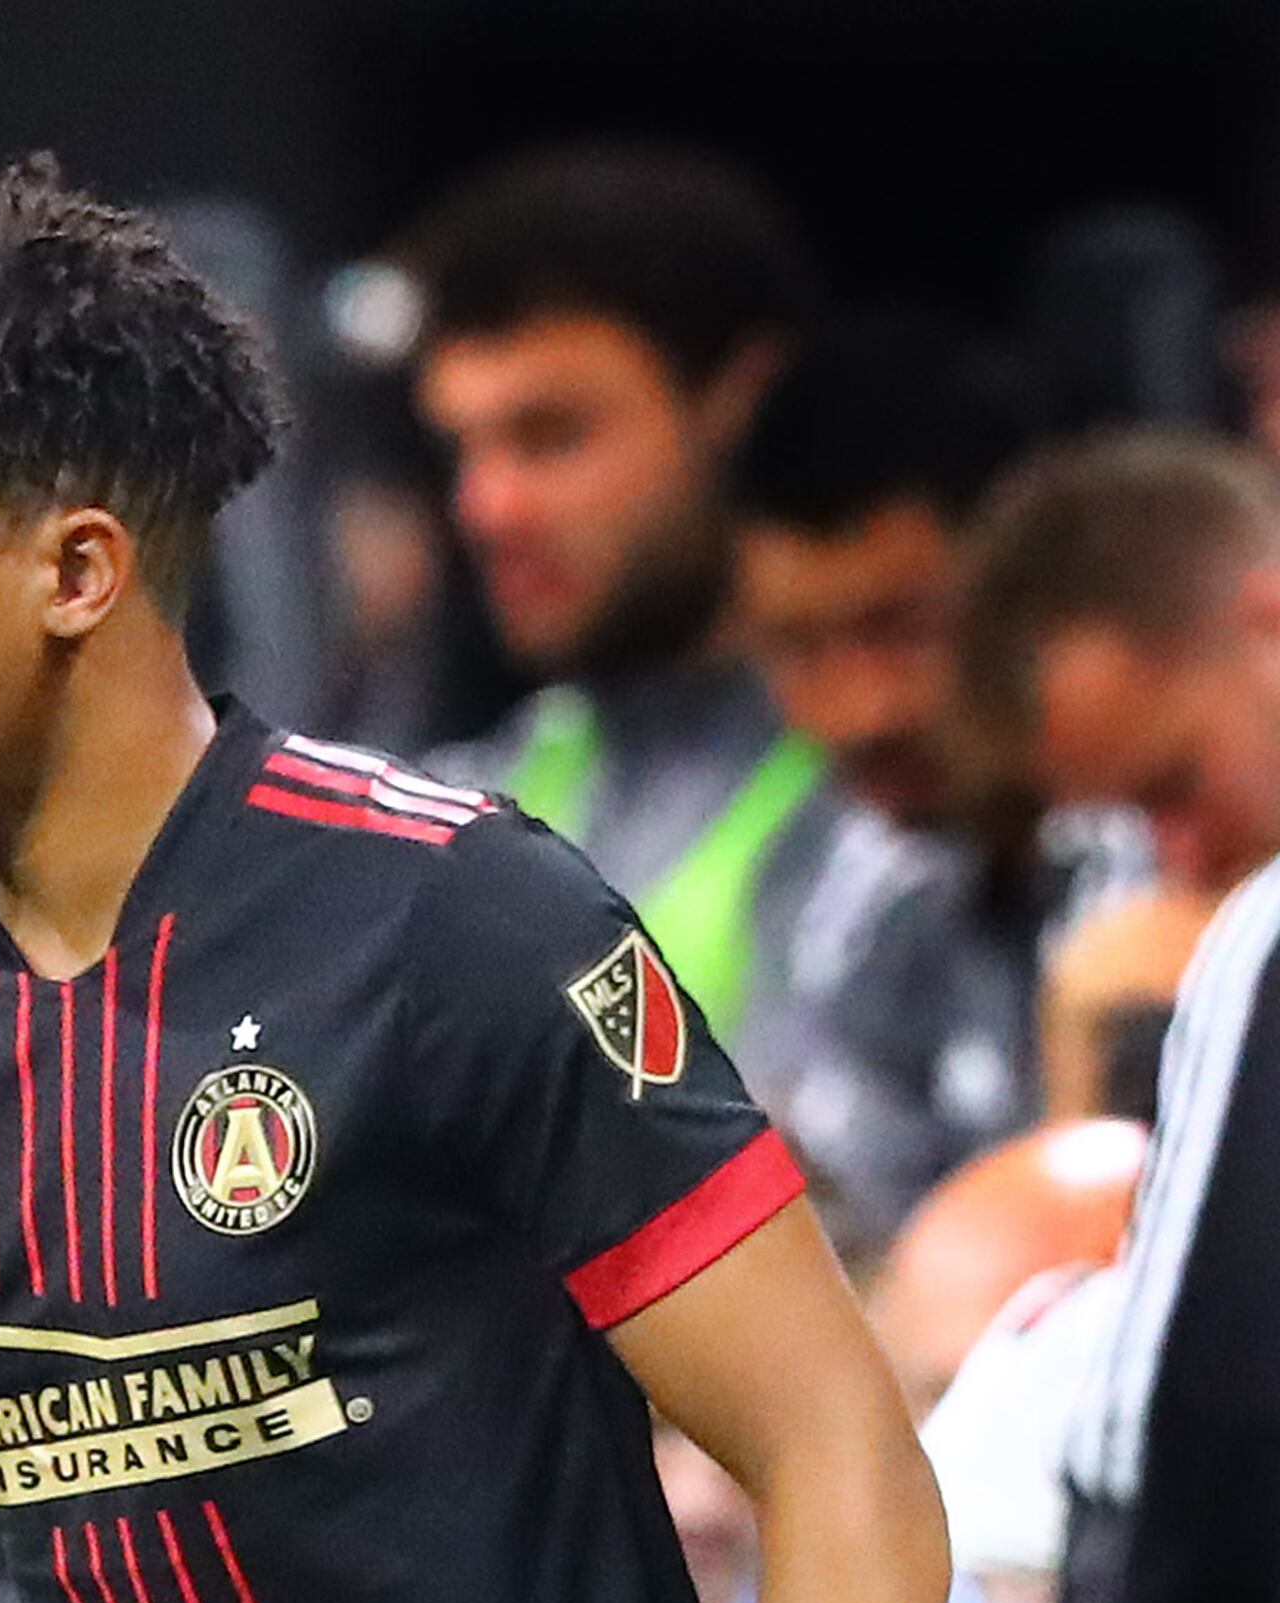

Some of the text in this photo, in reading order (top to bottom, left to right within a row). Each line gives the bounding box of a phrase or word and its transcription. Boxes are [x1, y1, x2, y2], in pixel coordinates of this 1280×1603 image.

[582, 963, 633, 1015] MLS
[195, 1072, 295, 1117] ATLANTA
[211, 1107, 285, 1202] A
[191, 1178, 301, 1229] UNITED FC
[123, 1334, 317, 1422] FAMILY
